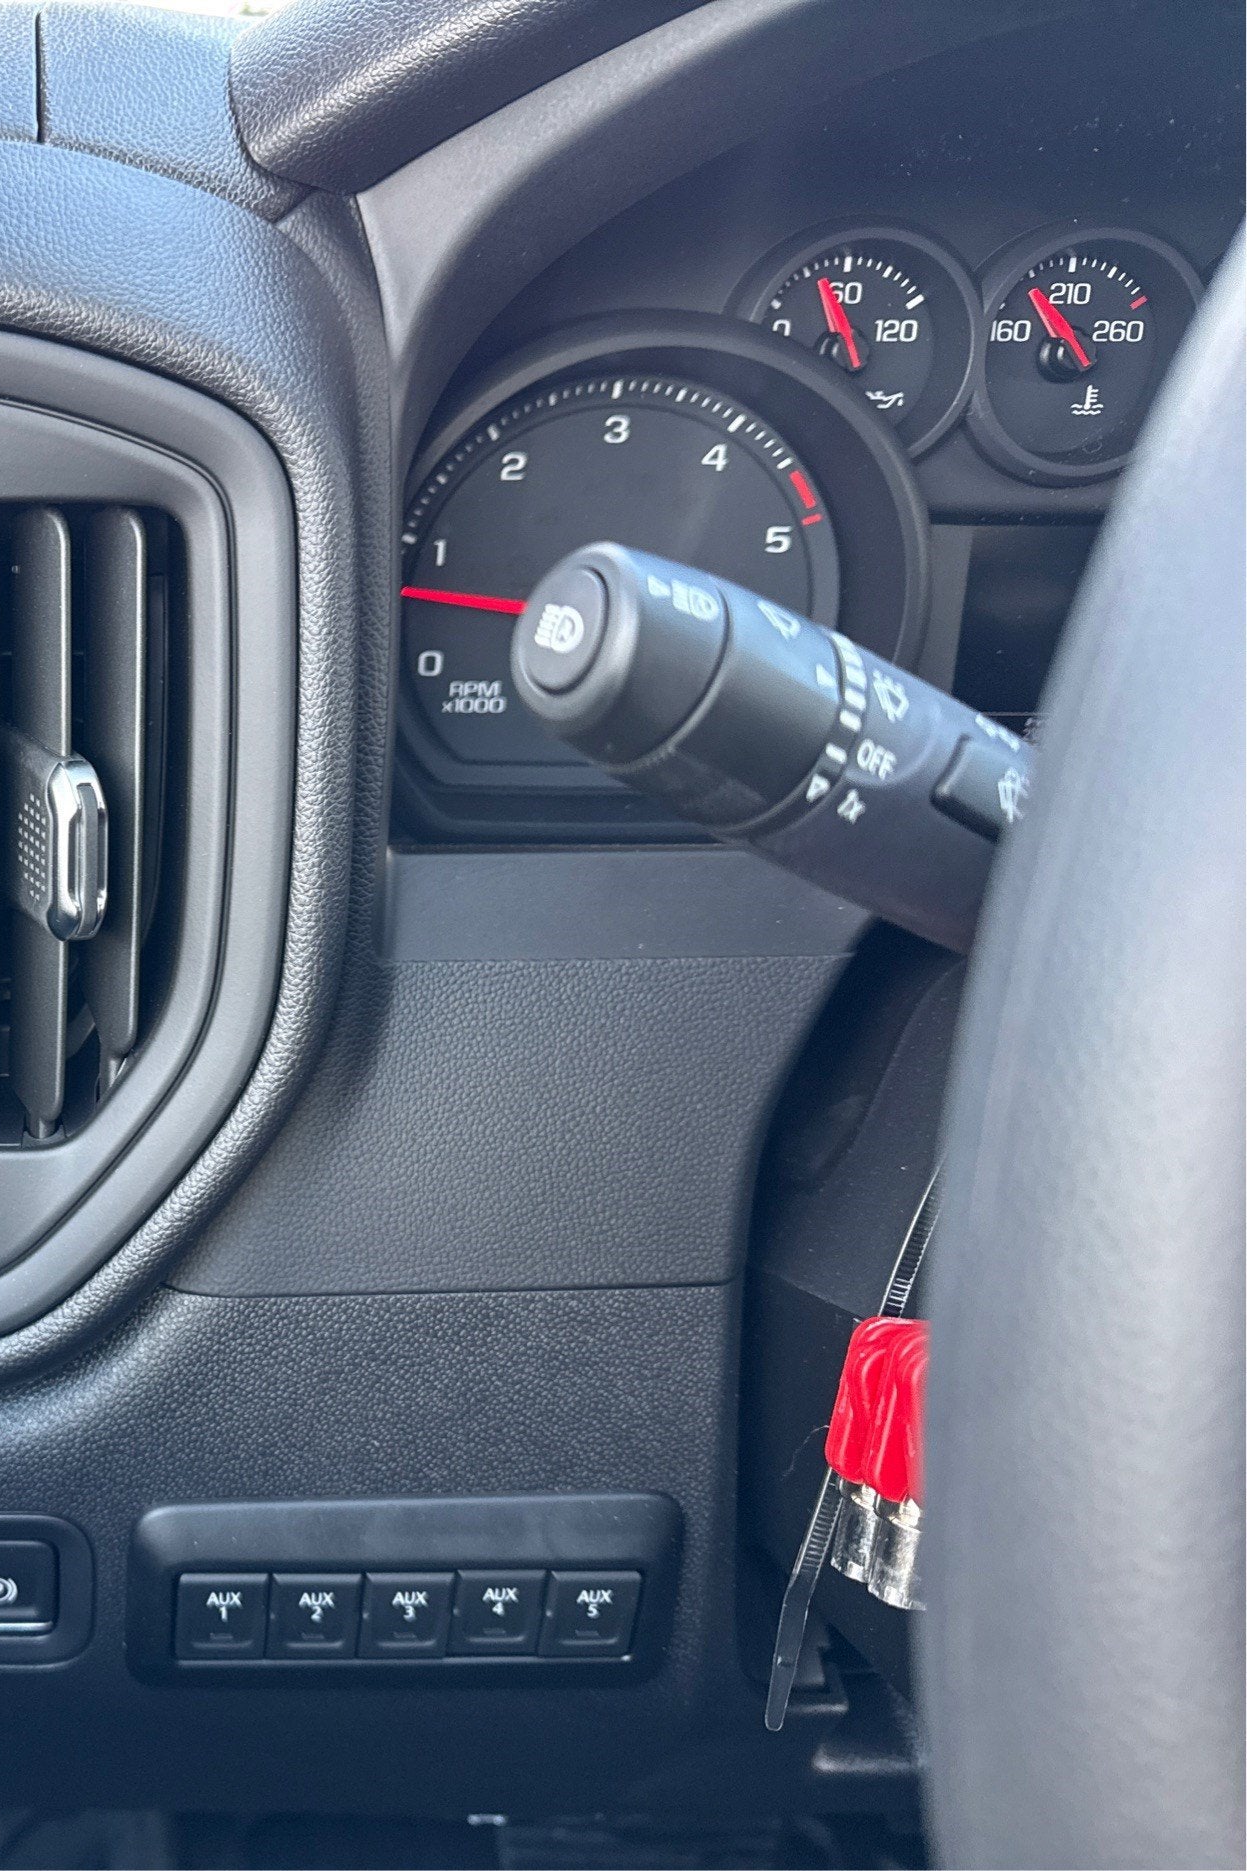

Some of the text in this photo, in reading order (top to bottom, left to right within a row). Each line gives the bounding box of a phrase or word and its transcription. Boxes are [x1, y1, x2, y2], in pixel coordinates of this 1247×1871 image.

[1049, 283, 1092, 304] 210
[874, 319, 918, 342] 120
[990, 320, 1032, 342] 160
[1092, 320, 1144, 342] 260
[604, 414, 631, 444] 3
[500, 451, 528, 481] 2
[701, 443, 730, 472] 4
[764, 525, 792, 553] 5
[434, 538, 447, 567] 1
[417, 650, 444, 677] 0
[448, 681, 503, 698] RPM
[441, 696, 507, 714] x1000
[856, 738, 898, 781] OFF
[206, 1591, 243, 1608] AUX
[298, 1591, 336, 1608] AUX
[391, 1590, 428, 1607] AUX
[481, 1587, 519, 1602] AUX
[576, 1589, 614, 1605] AUX
[218, 1606, 229, 1623] 1
[310, 1606, 324, 1623] 2
[403, 1605, 416, 1622] 3
[491, 1601, 505, 1616] 4
[587, 1604, 600, 1619] 5
